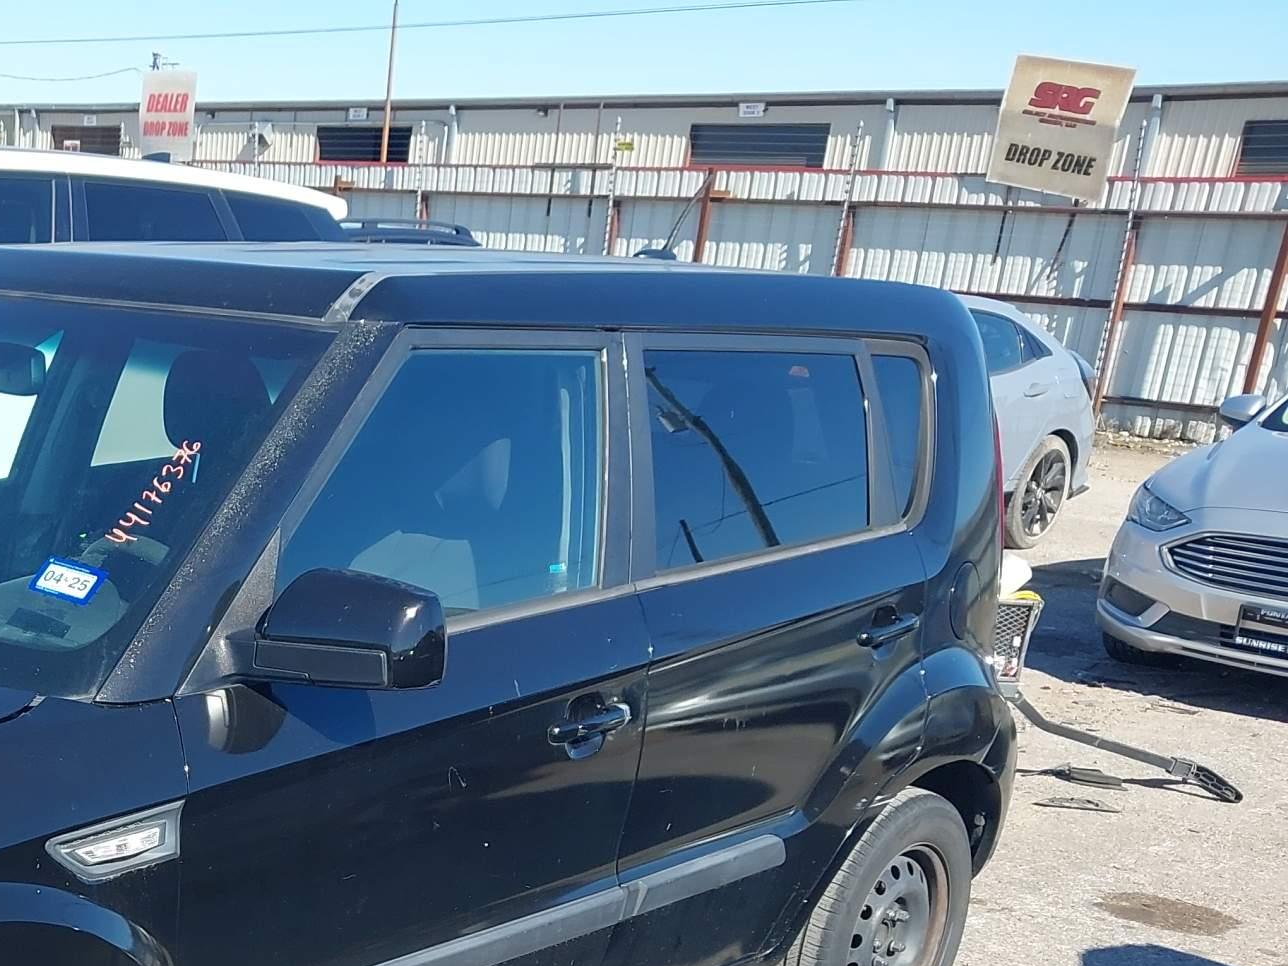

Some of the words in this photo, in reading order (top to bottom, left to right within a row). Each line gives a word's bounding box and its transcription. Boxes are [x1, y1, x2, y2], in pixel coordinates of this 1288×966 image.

[146, 93, 189, 113] DEALER
[1028, 81, 1101, 115] SRG
[143, 121, 165, 136] DROP
[167, 121, 189, 136] ZONE
[1005, 143, 1052, 168] DROP
[1051, 151, 1096, 176] ZONE
[1235, 636, 1286, 652] SUNRISE
